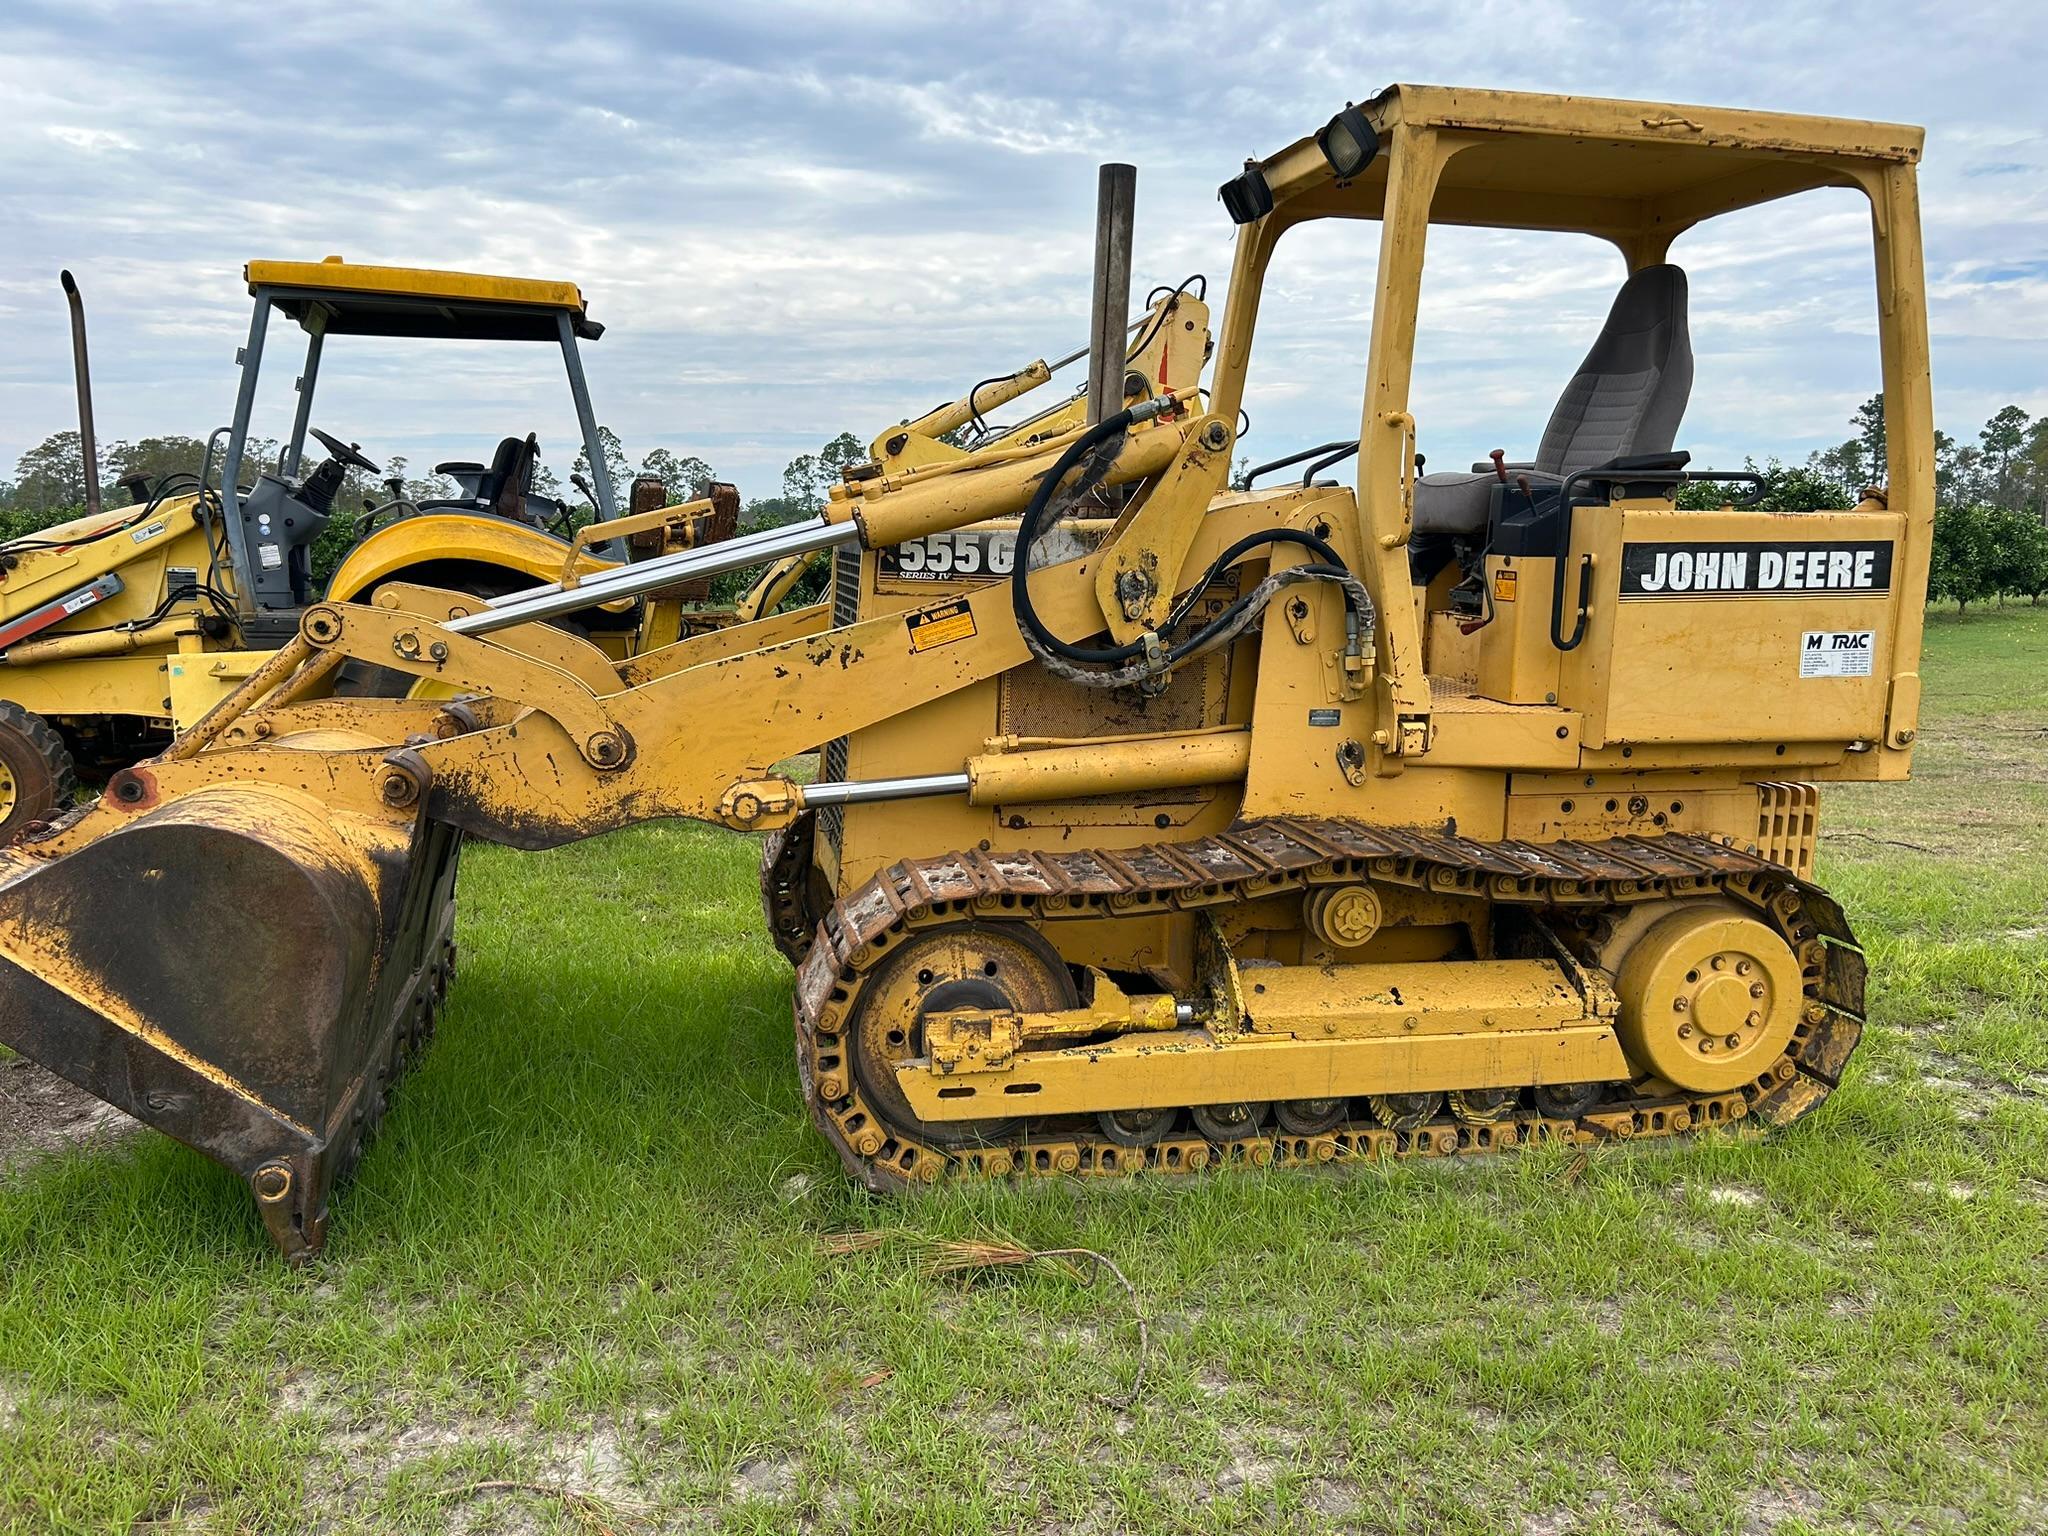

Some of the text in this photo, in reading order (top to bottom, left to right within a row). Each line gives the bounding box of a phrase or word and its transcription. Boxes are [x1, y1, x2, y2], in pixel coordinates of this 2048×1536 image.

[899, 533, 1017, 573] 555 G
[899, 572, 936, 580] SERIES
[1640, 550, 1876, 592] JOHN DEERE
[930, 605, 959, 621] WARNING
[1831, 633, 1870, 650] TRAC
